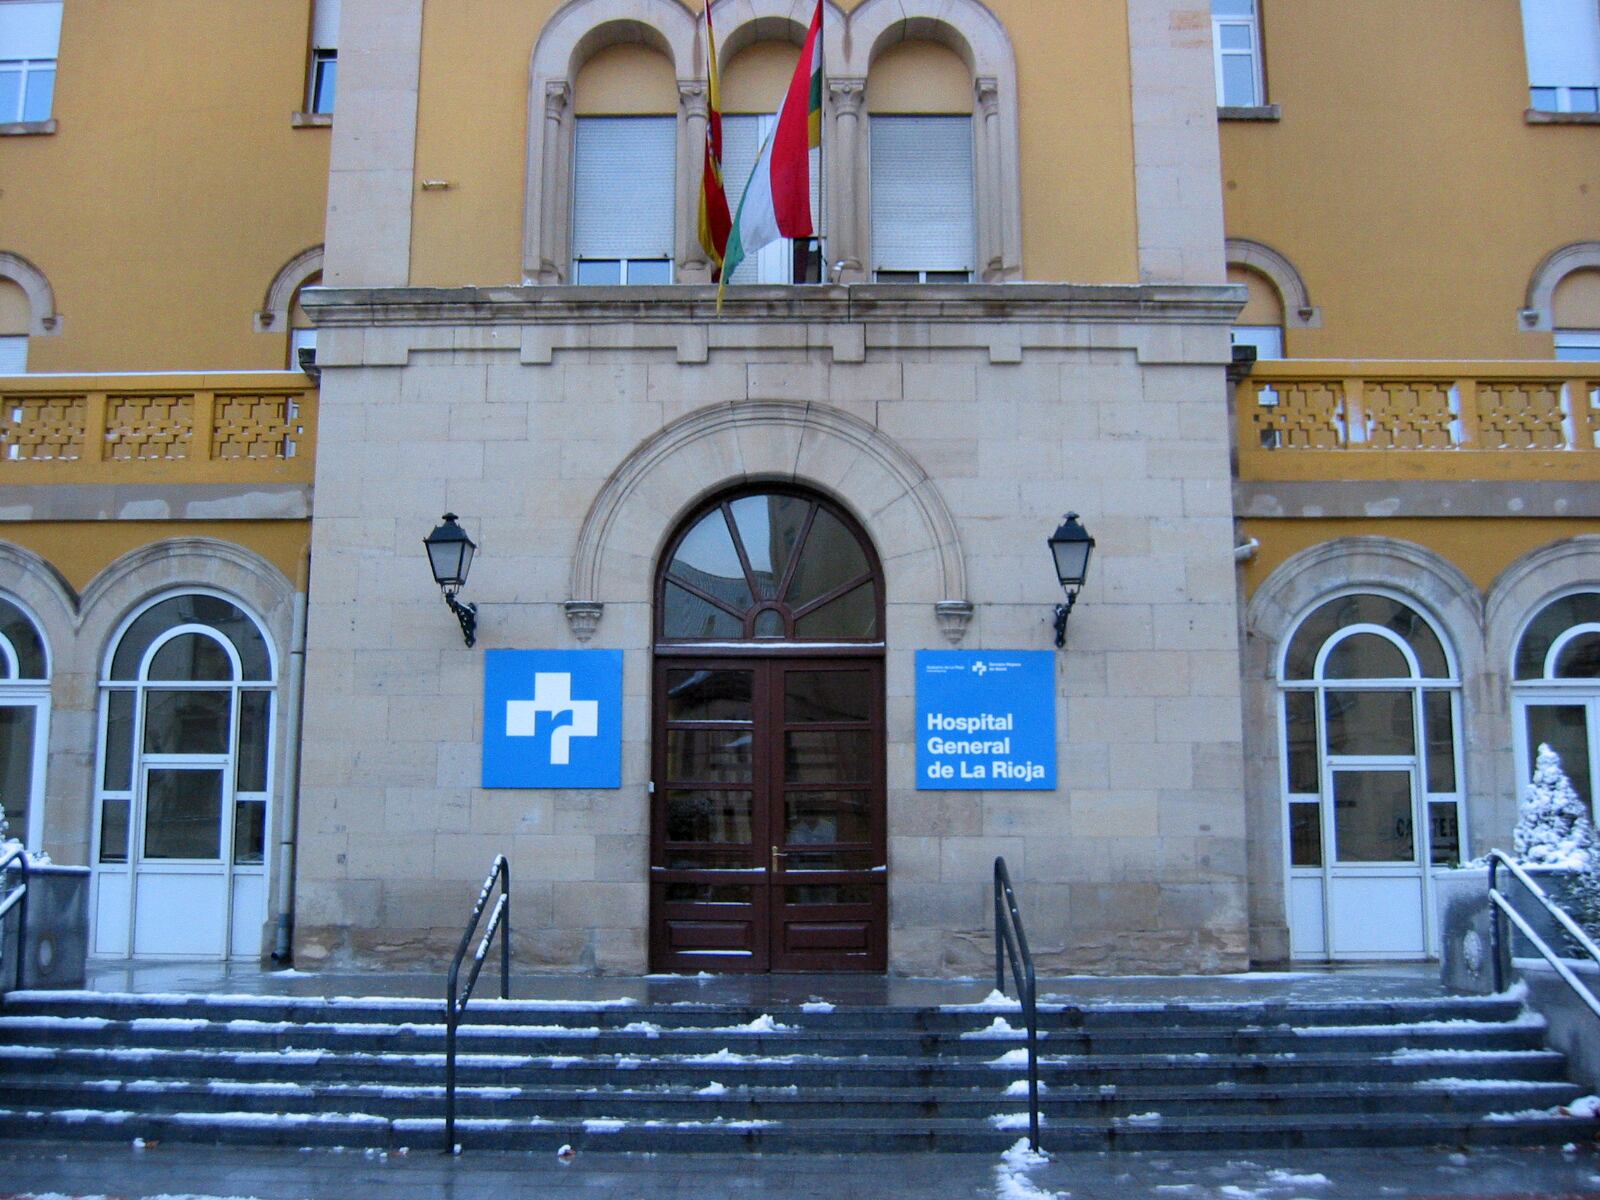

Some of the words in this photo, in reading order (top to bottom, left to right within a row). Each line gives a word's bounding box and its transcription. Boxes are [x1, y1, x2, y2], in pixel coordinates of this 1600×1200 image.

[927, 713, 1013, 734] Hospital
[927, 737, 1010, 755] General
[927, 761, 954, 778] de
[960, 761, 986, 778] La
[992, 761, 1045, 782] Rioja
